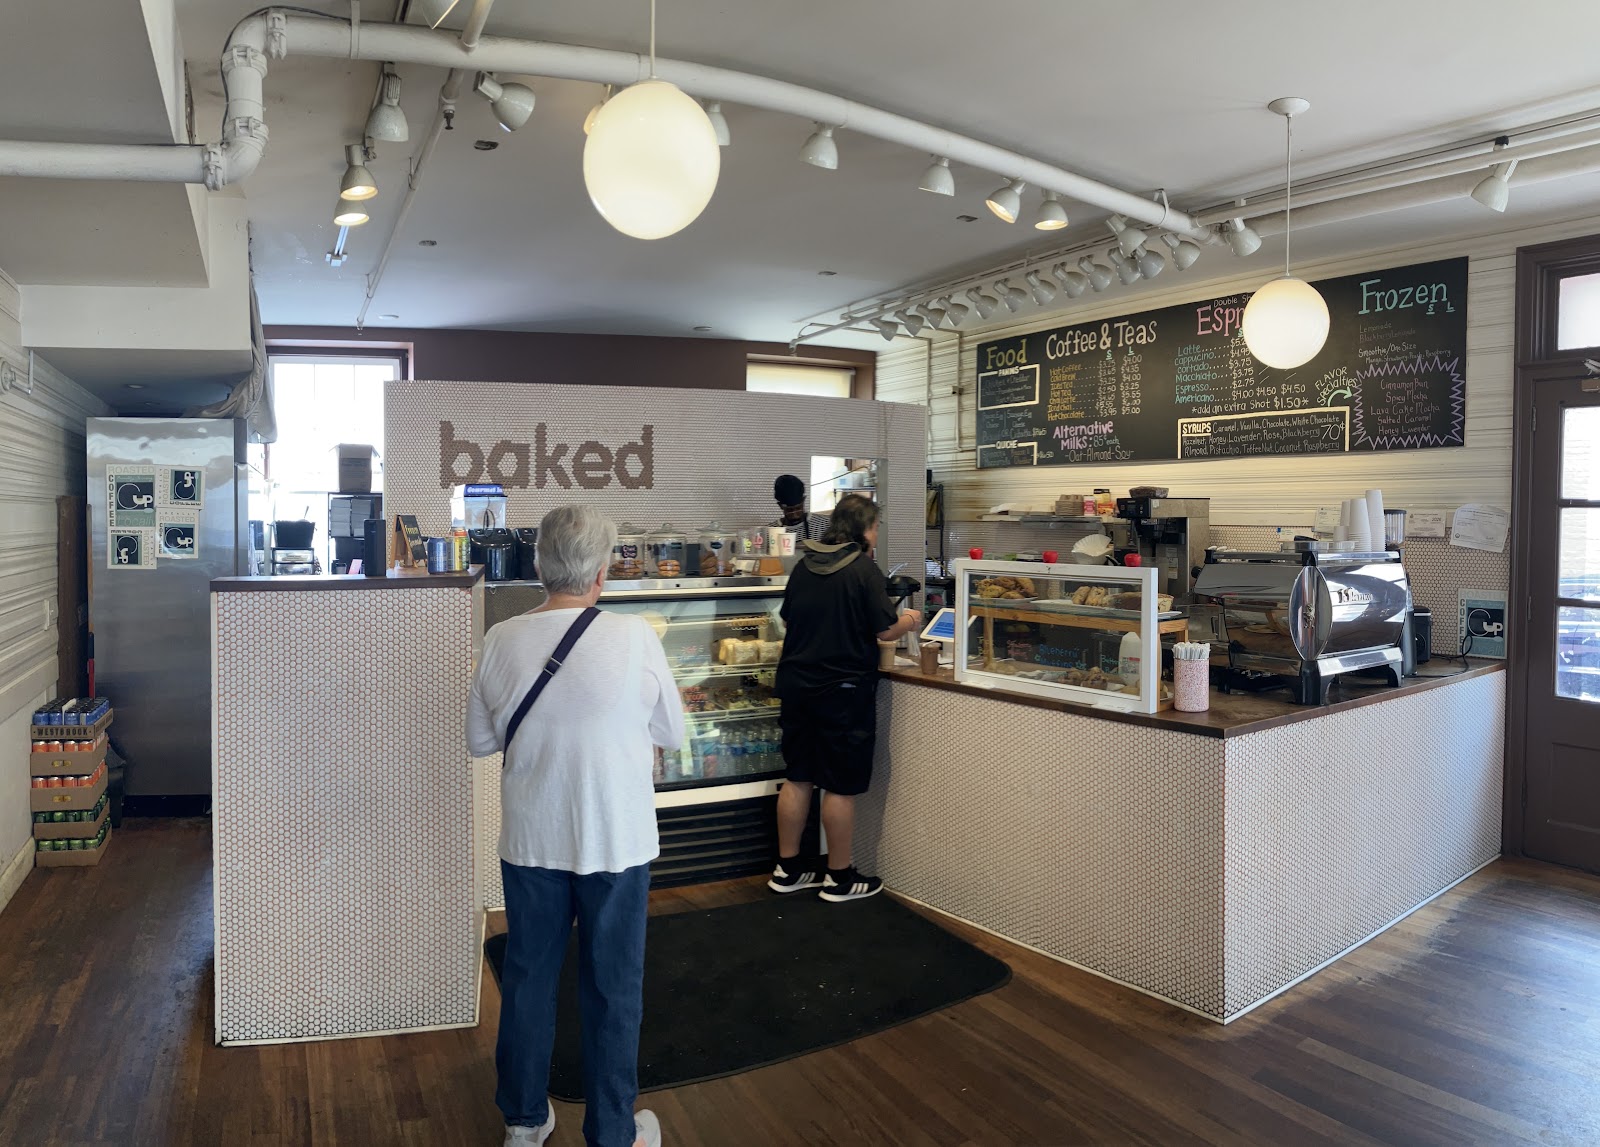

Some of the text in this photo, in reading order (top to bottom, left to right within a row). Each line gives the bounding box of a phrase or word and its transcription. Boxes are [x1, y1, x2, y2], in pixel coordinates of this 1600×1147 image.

[1213, 296, 1238, 308] Double
[1358, 278, 1448, 315] Frozen
[1196, 305, 1245, 337] Espr
[1360, 321, 1392, 334] Lemonade
[1046, 320, 1158, 360] Coffee & Teas
[1178, 337, 1247, 357] Latte $5.2
[1402, 341, 1416, 352] Size
[986, 338, 1027, 370] Food
[1061, 363, 1081, 373] Coffee
[1229, 357, 1252, 369] $3.75
[1175, 367, 1254, 383] Macchiato $3.75
[1314, 366, 1348, 391] FLAVOR
[1175, 378, 1255, 395] Espresso $2.75
[1380, 378, 1429, 390] Cinnamon Bun
[1174, 383, 1306, 404] Americano $4.00 $4.50 $4.50
[1386, 390, 1428, 404] Spicy Mocha
[1224, 400, 1247, 412] extra
[1370, 402, 1440, 416] Lava Cake Mocha
[1182, 422, 1211, 434] SYRUPS
[1292, 417, 1309, 426] White
[1309, 414, 1340, 425] Chocolate
[1377, 413, 1432, 425] Salted Caramel
[1053, 420, 1114, 439] Alternative
[1282, 427, 1320, 439] Blackberry
[1320, 421, 1346, 441] 70¢
[1379, 425, 1399, 437] Honey
[1303, 439, 1340, 453] Raspberry
[439, 420, 654, 490] baked
[107, 465, 155, 474] ROASTED
[162, 468, 170, 505] ROASTED
[159, 515, 196, 523] ROASTED
[37, 727, 88, 737] WESTBROOK
